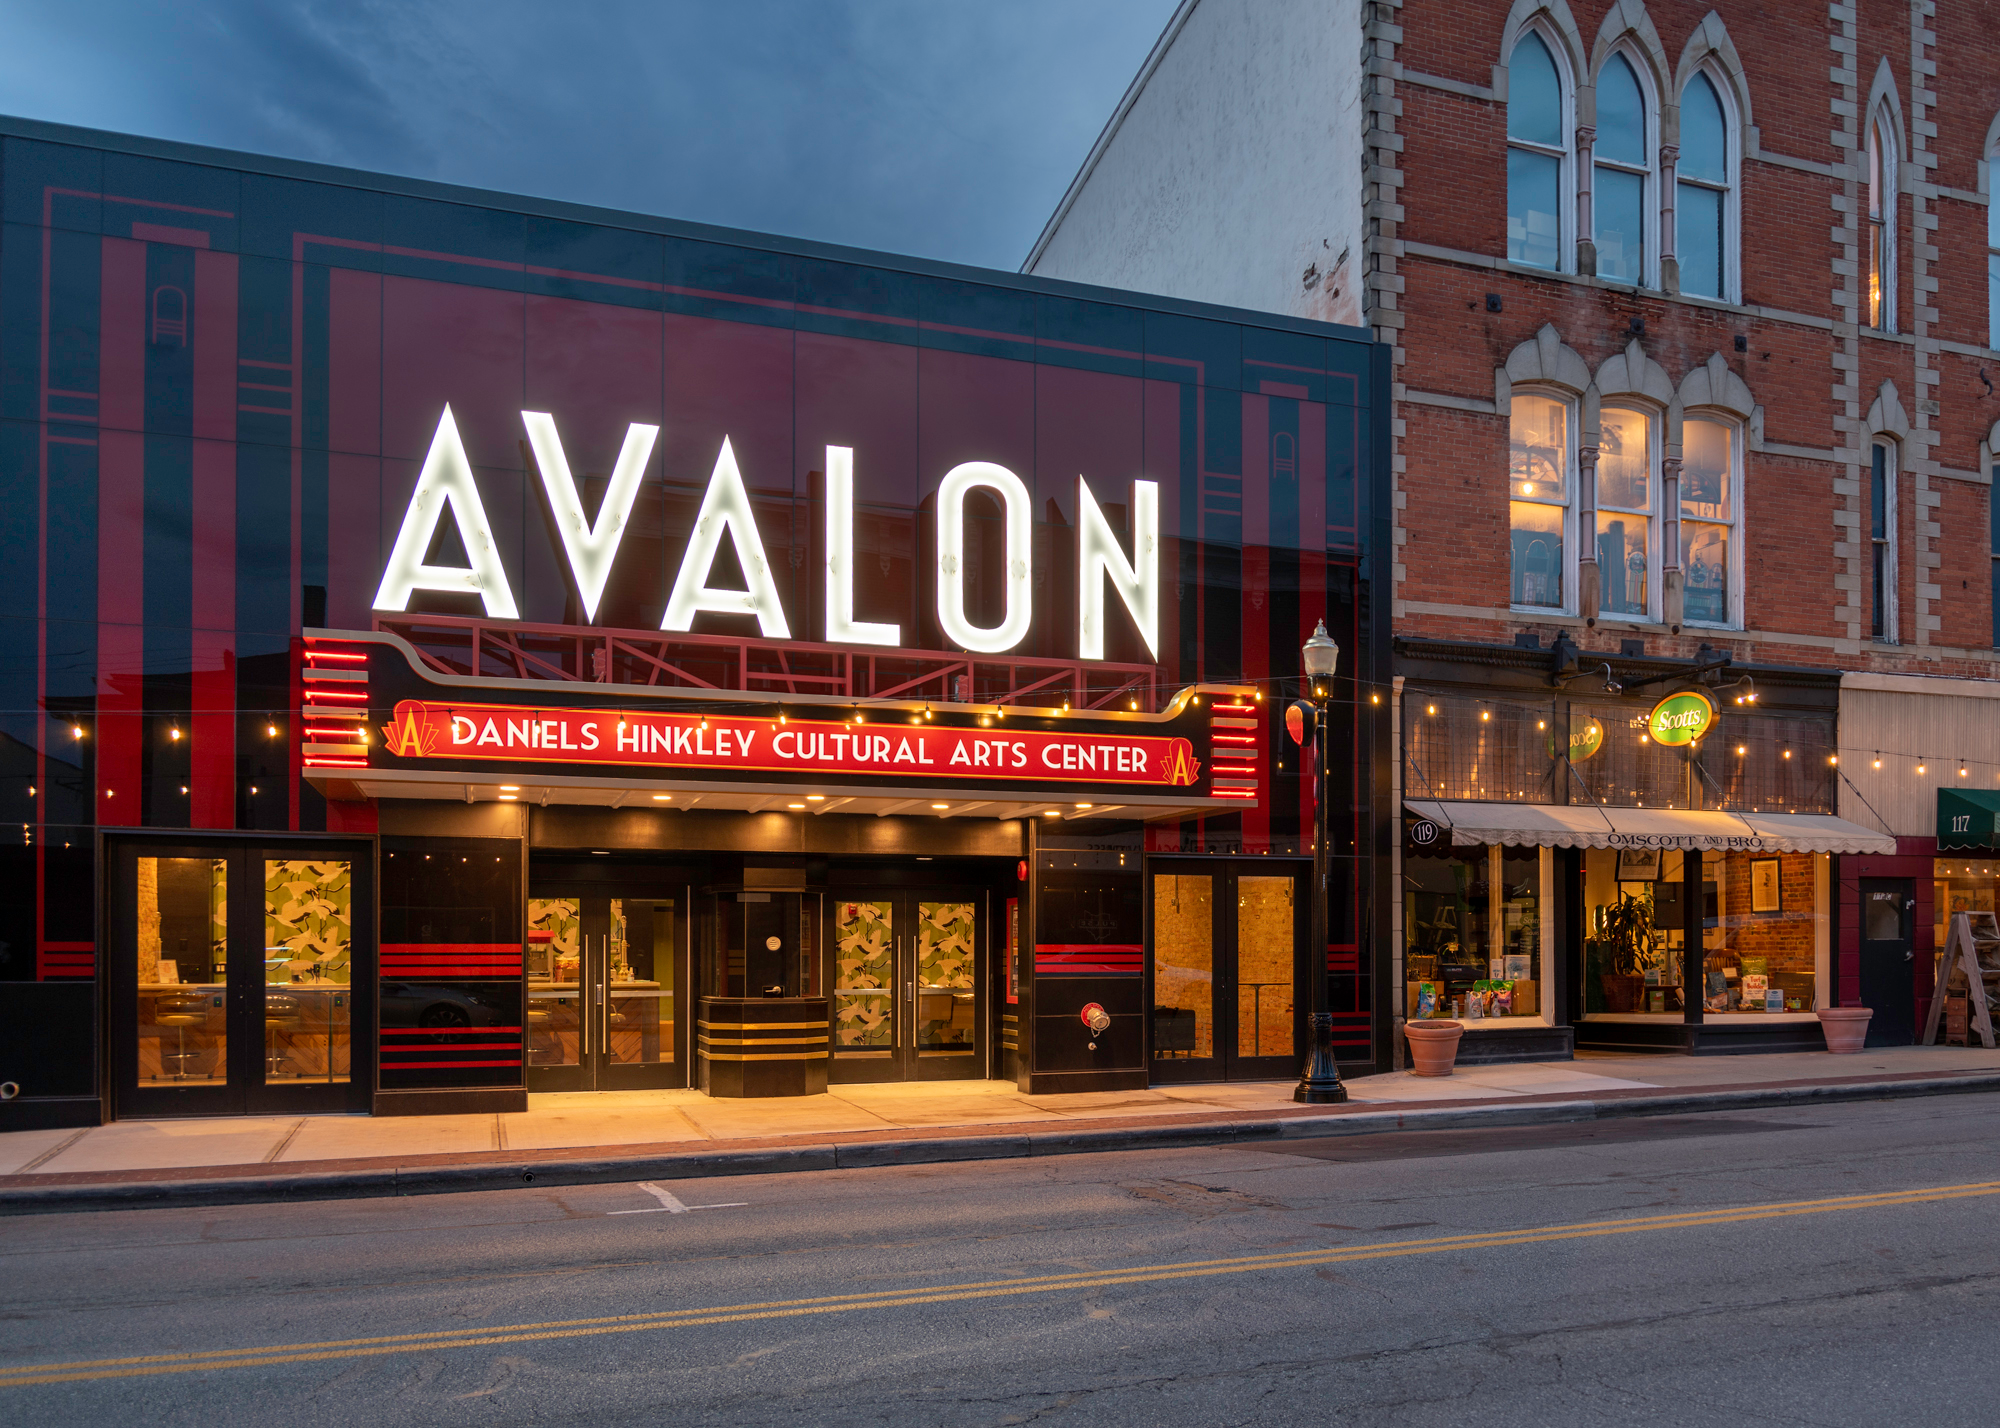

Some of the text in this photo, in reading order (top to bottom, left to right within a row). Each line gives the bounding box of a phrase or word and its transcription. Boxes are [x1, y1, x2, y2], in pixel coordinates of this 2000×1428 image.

[372, 402, 1159, 663] AVALON
[452, 715, 1148, 773] DANIELS HINKLEY CULTURAL ARTS CENTER
[1417, 823, 1433, 841] 119
[1951, 815, 1970, 832] 117
[1702, 836, 1723, 845] AND
